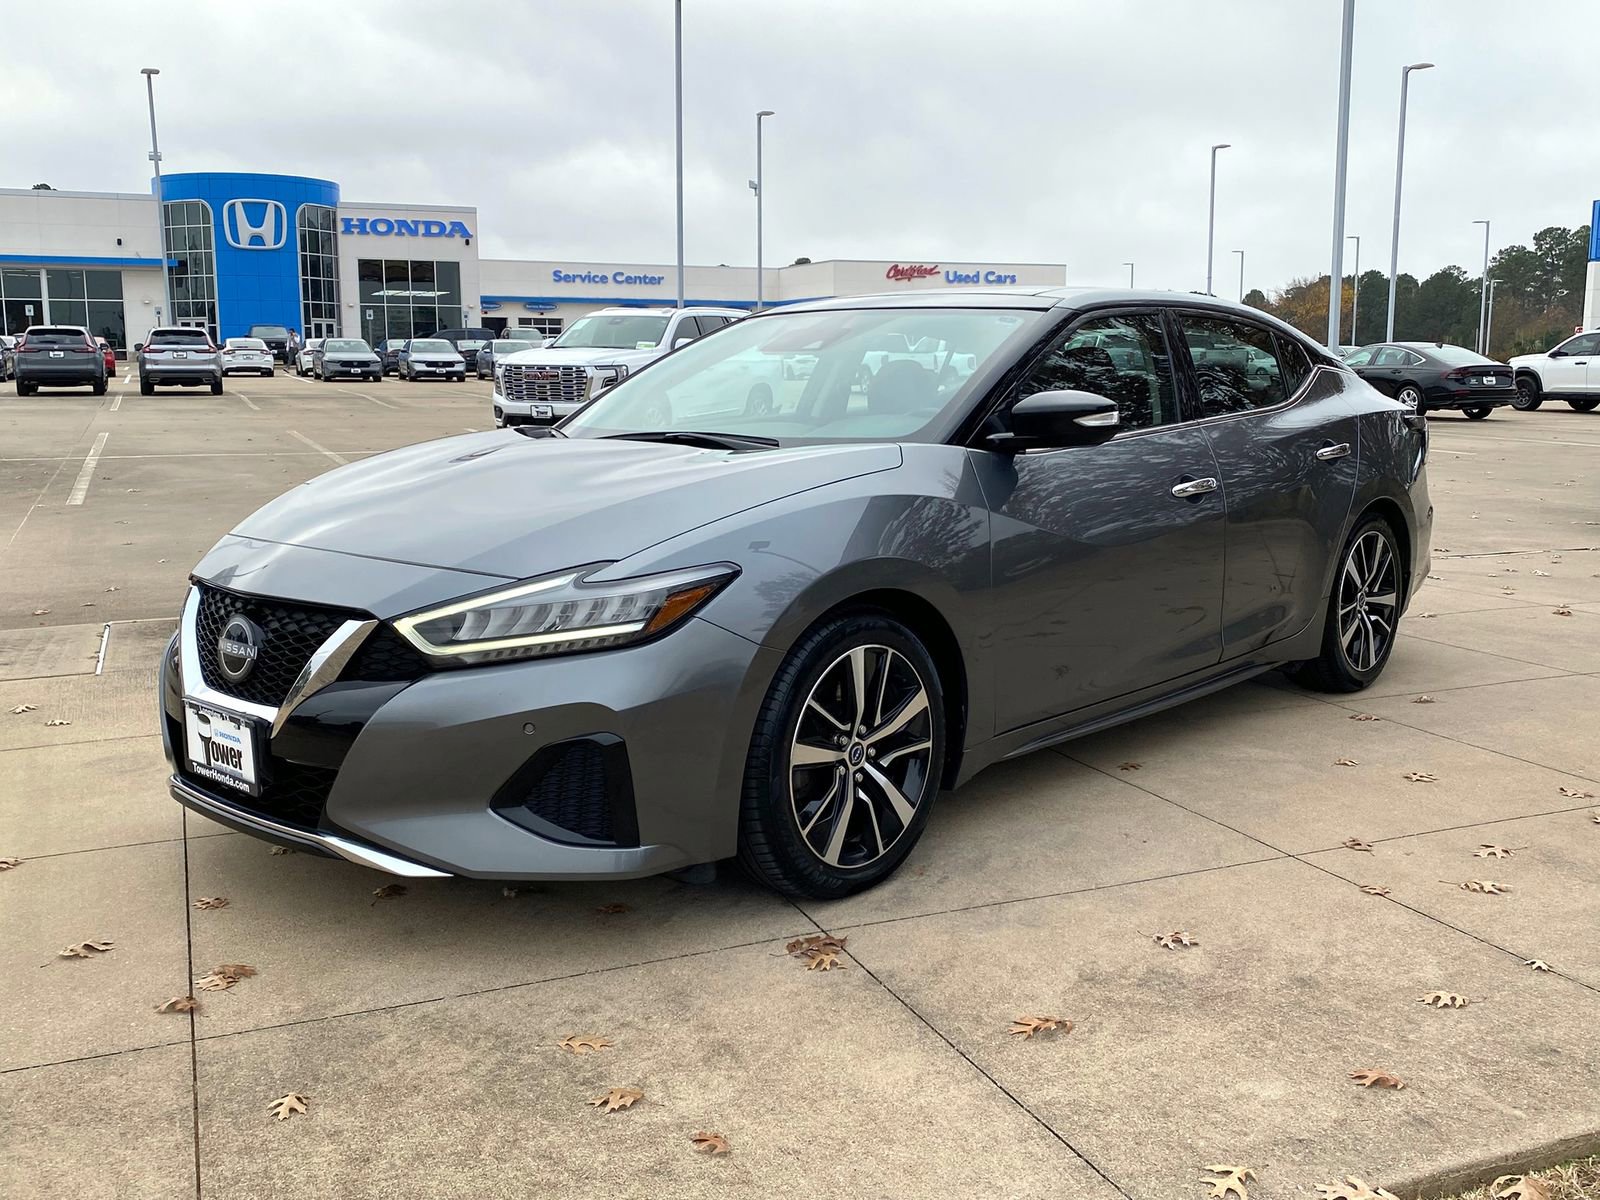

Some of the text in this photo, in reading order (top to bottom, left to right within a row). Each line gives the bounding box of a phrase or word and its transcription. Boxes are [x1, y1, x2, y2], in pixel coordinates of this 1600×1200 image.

[340, 217, 474, 239] HONDA
[552, 269, 665, 286] Service Center
[944, 270, 980, 284] Used
[983, 271, 1017, 285] Cars
[198, 733, 243, 770] Tower
[191, 761, 251, 793] TowerHonda.com
